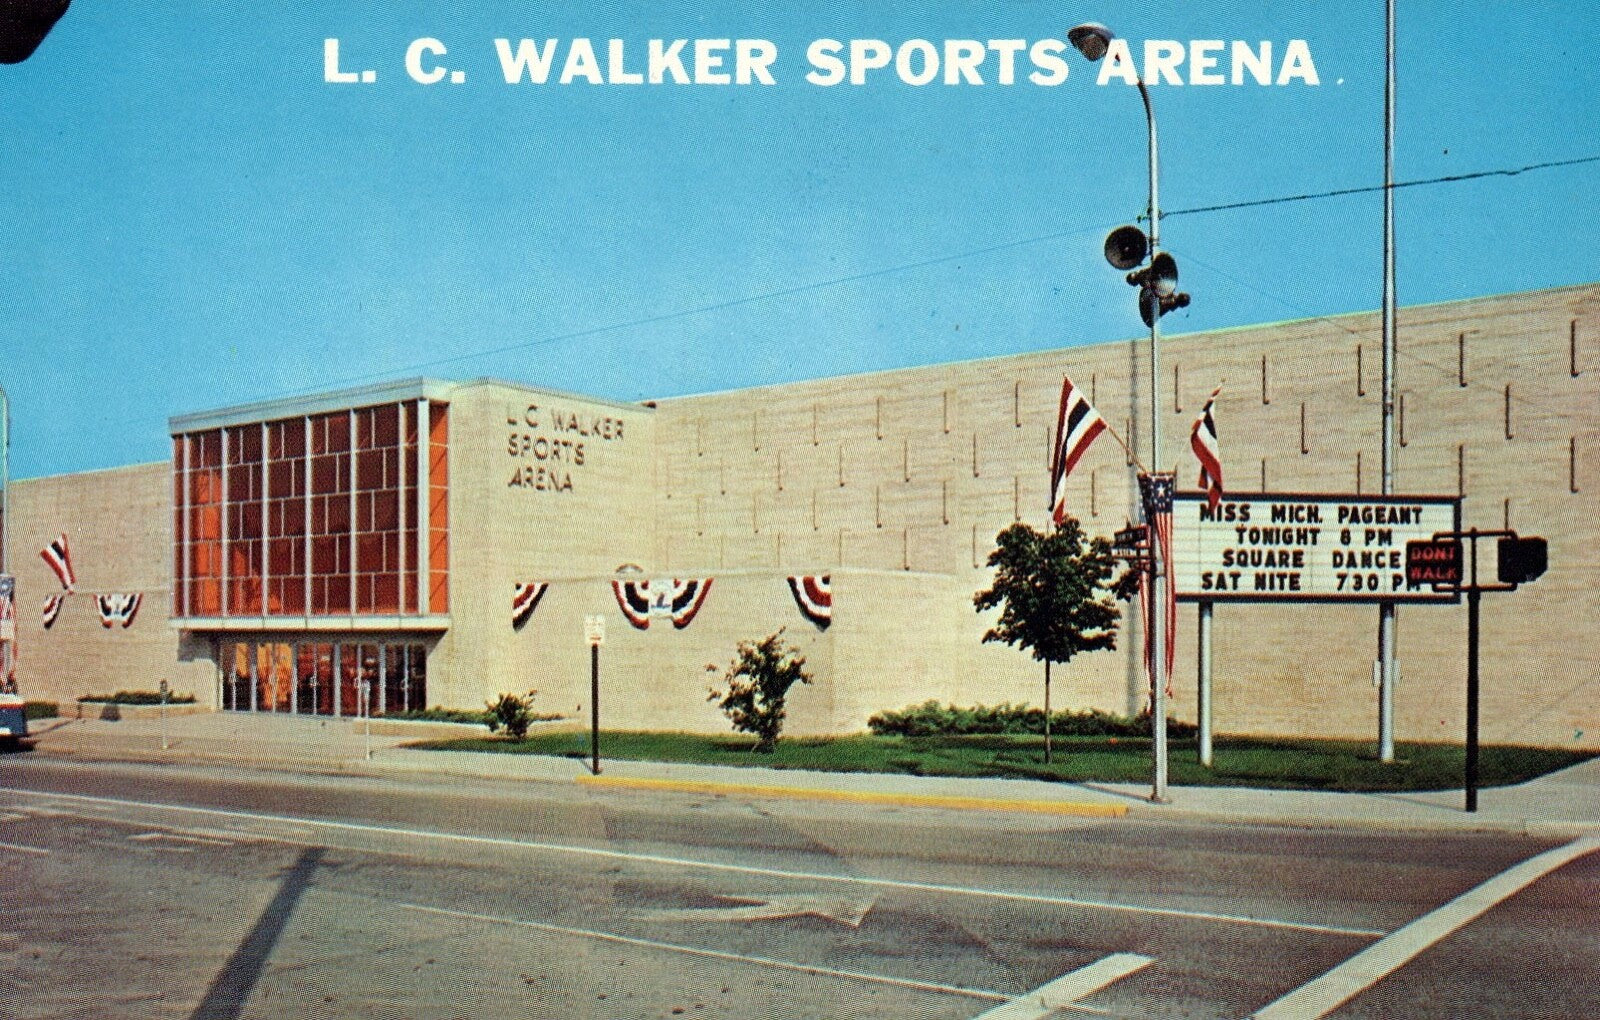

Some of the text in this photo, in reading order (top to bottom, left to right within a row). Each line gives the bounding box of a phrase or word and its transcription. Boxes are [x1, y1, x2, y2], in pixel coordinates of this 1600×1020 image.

[525, 404, 539, 428] C
[551, 408, 624, 440] WALKER
[507, 432, 585, 466] SPORTS
[507, 466, 574, 494] ARENA
[1200, 504, 1423, 525] MISS MICH. PAGEANT
[1236, 526, 1393, 546] TONIGHT 8 PM
[1222, 550, 1402, 569] SQUARE DANCE
[1410, 546, 1456, 561] DONT
[1202, 572, 1241, 590] SAT
[1255, 572, 1301, 591] NITE
[1336, 573, 1379, 591] 730
[1410, 566, 1457, 580] WALK
